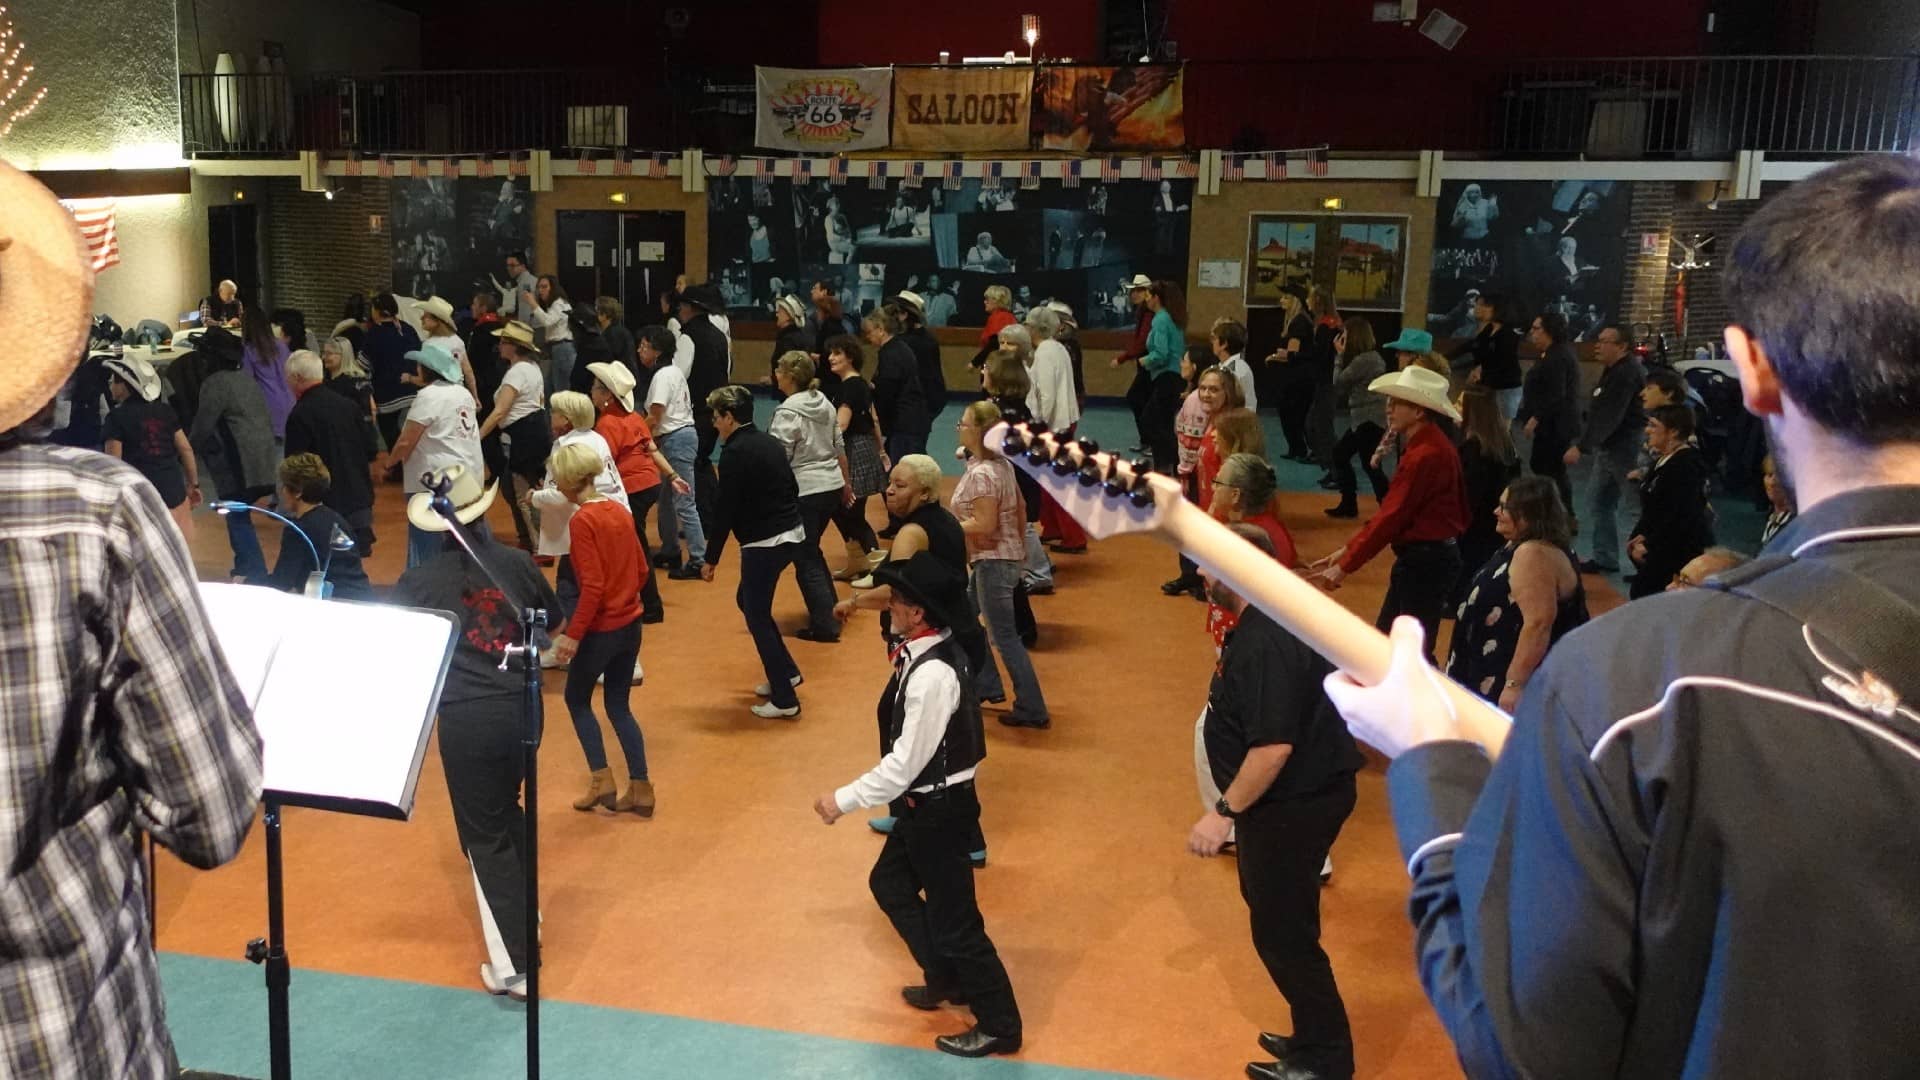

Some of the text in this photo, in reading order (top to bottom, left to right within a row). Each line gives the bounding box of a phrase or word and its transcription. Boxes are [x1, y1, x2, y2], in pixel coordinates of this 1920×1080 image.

[810, 96, 837, 105] ROUTE
[907, 93, 1021, 124] SALOON
[810, 106, 836, 123] 66
